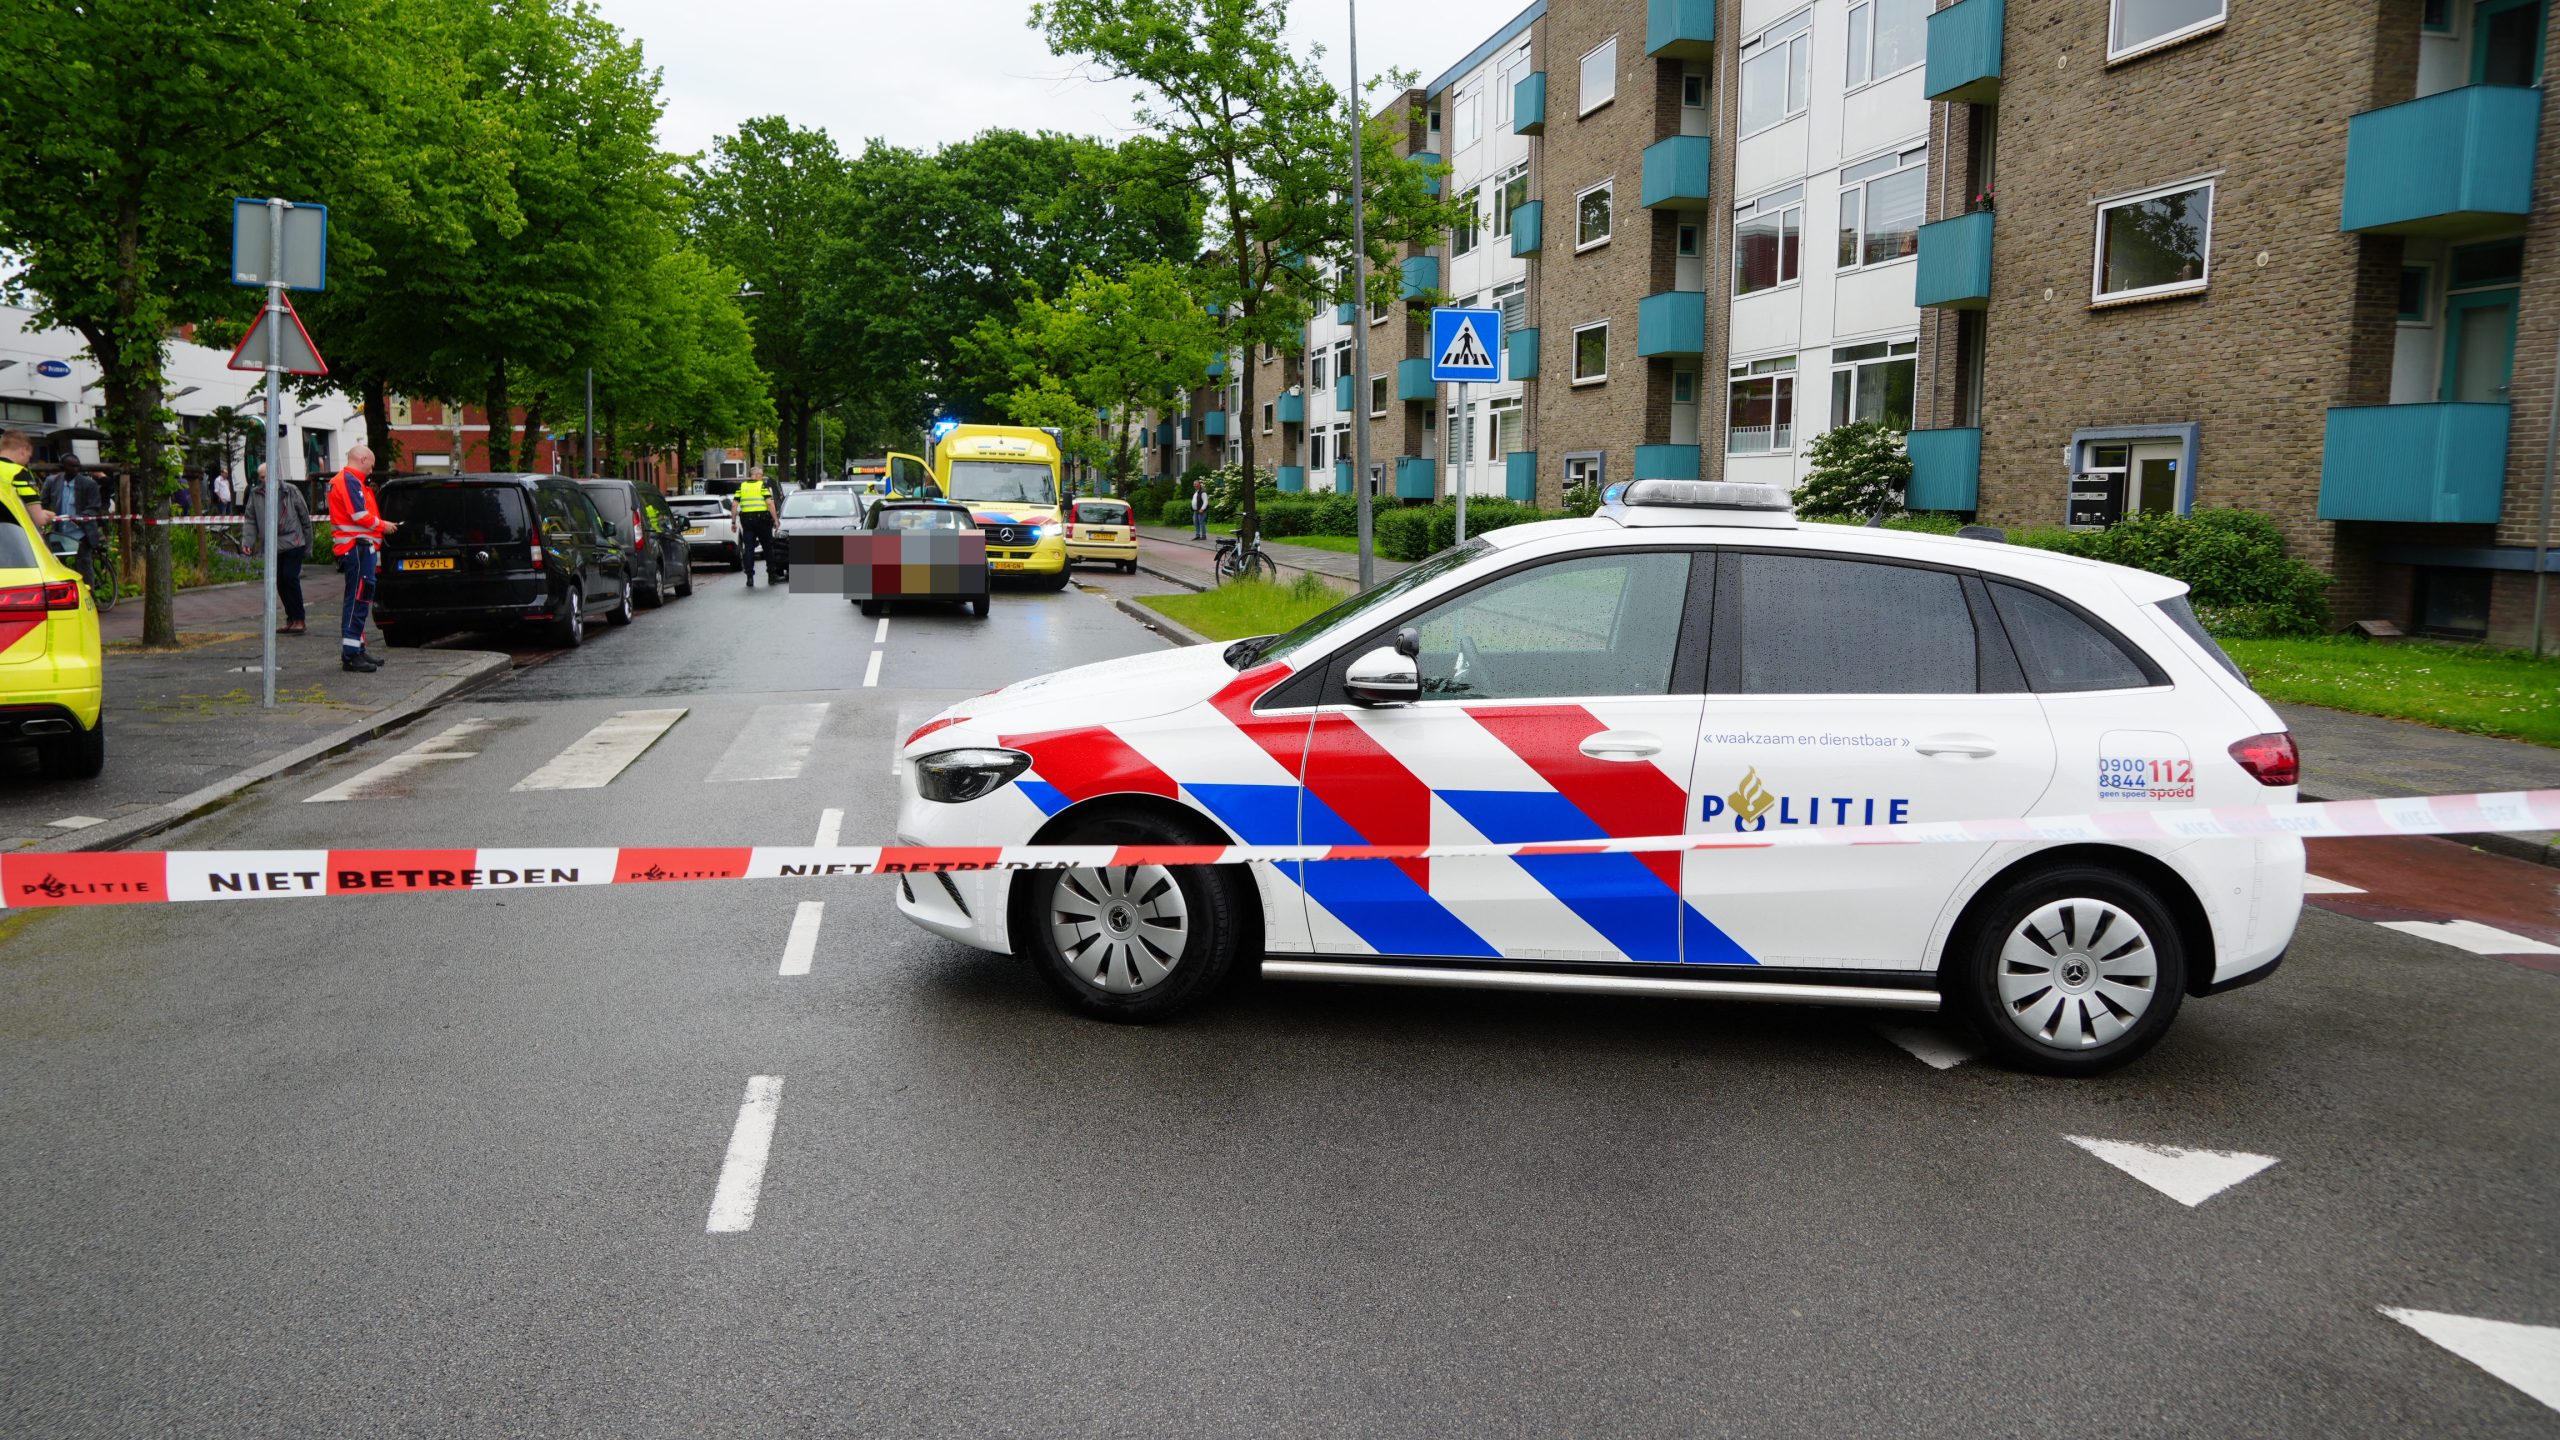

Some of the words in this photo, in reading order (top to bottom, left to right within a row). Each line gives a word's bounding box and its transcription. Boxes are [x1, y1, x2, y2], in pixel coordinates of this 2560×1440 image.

[408, 560, 449, 569] VSV-61-L
[1716, 732, 1795, 745] waakzaam
[1799, 736, 1816, 745] en
[1819, 733, 1898, 747] dienstbaar
[2100, 758, 2145, 772] 0900
[2148, 759, 2194, 783] 112
[2099, 774, 2146, 788] 8844
[2099, 791, 2120, 799] geen
[2121, 790, 2146, 799] spoed
[2149, 785, 2194, 800] spoed
[1702, 791, 1909, 832] POLITIE
[779, 863, 873, 876] NIET
[22, 877, 150, 898] POLITIE
[208, 872, 320, 892] NIET
[338, 868, 580, 889] BETREDEN
